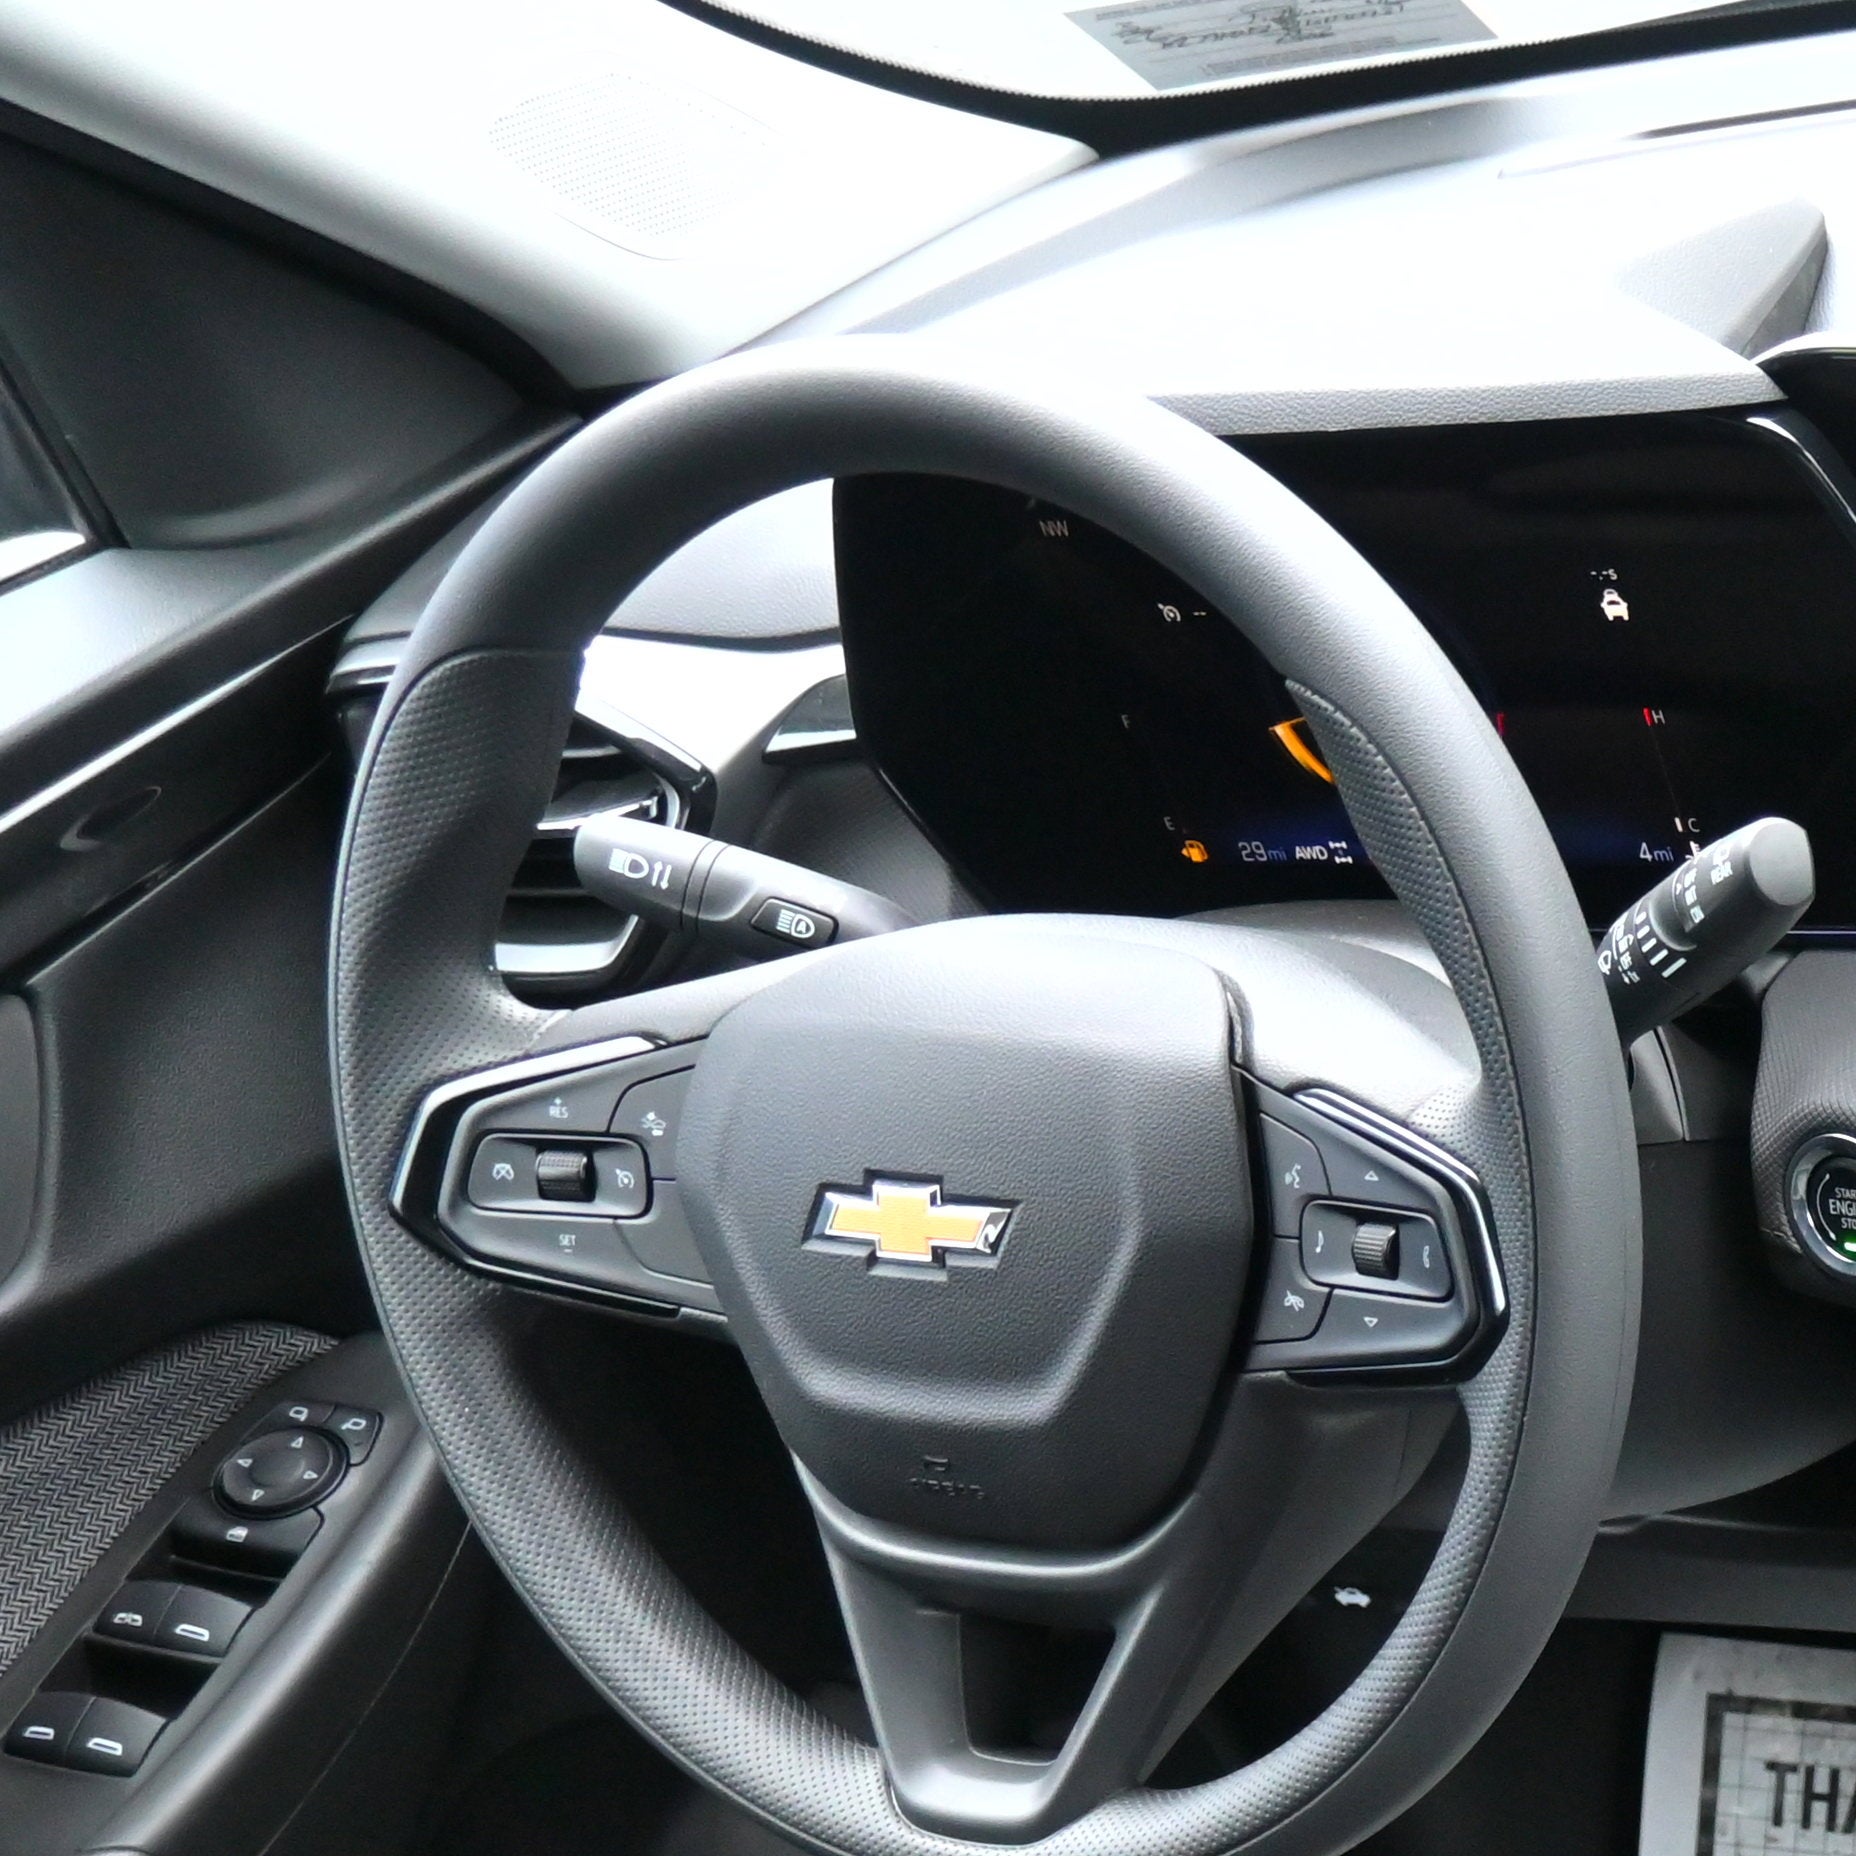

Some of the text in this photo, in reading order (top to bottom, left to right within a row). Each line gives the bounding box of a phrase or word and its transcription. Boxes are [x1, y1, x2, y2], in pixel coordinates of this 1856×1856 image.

[1039, 520, 1069, 537] NW
[1121, 714, 1131, 728] F
[1652, 709, 1666, 725] H
[1163, 816, 1175, 831] E
[1687, 818, 1700, 833] C
[1294, 845, 1328, 861] AWD
[549, 1105, 568, 1118] RES
[559, 1235, 576, 1246] SET
